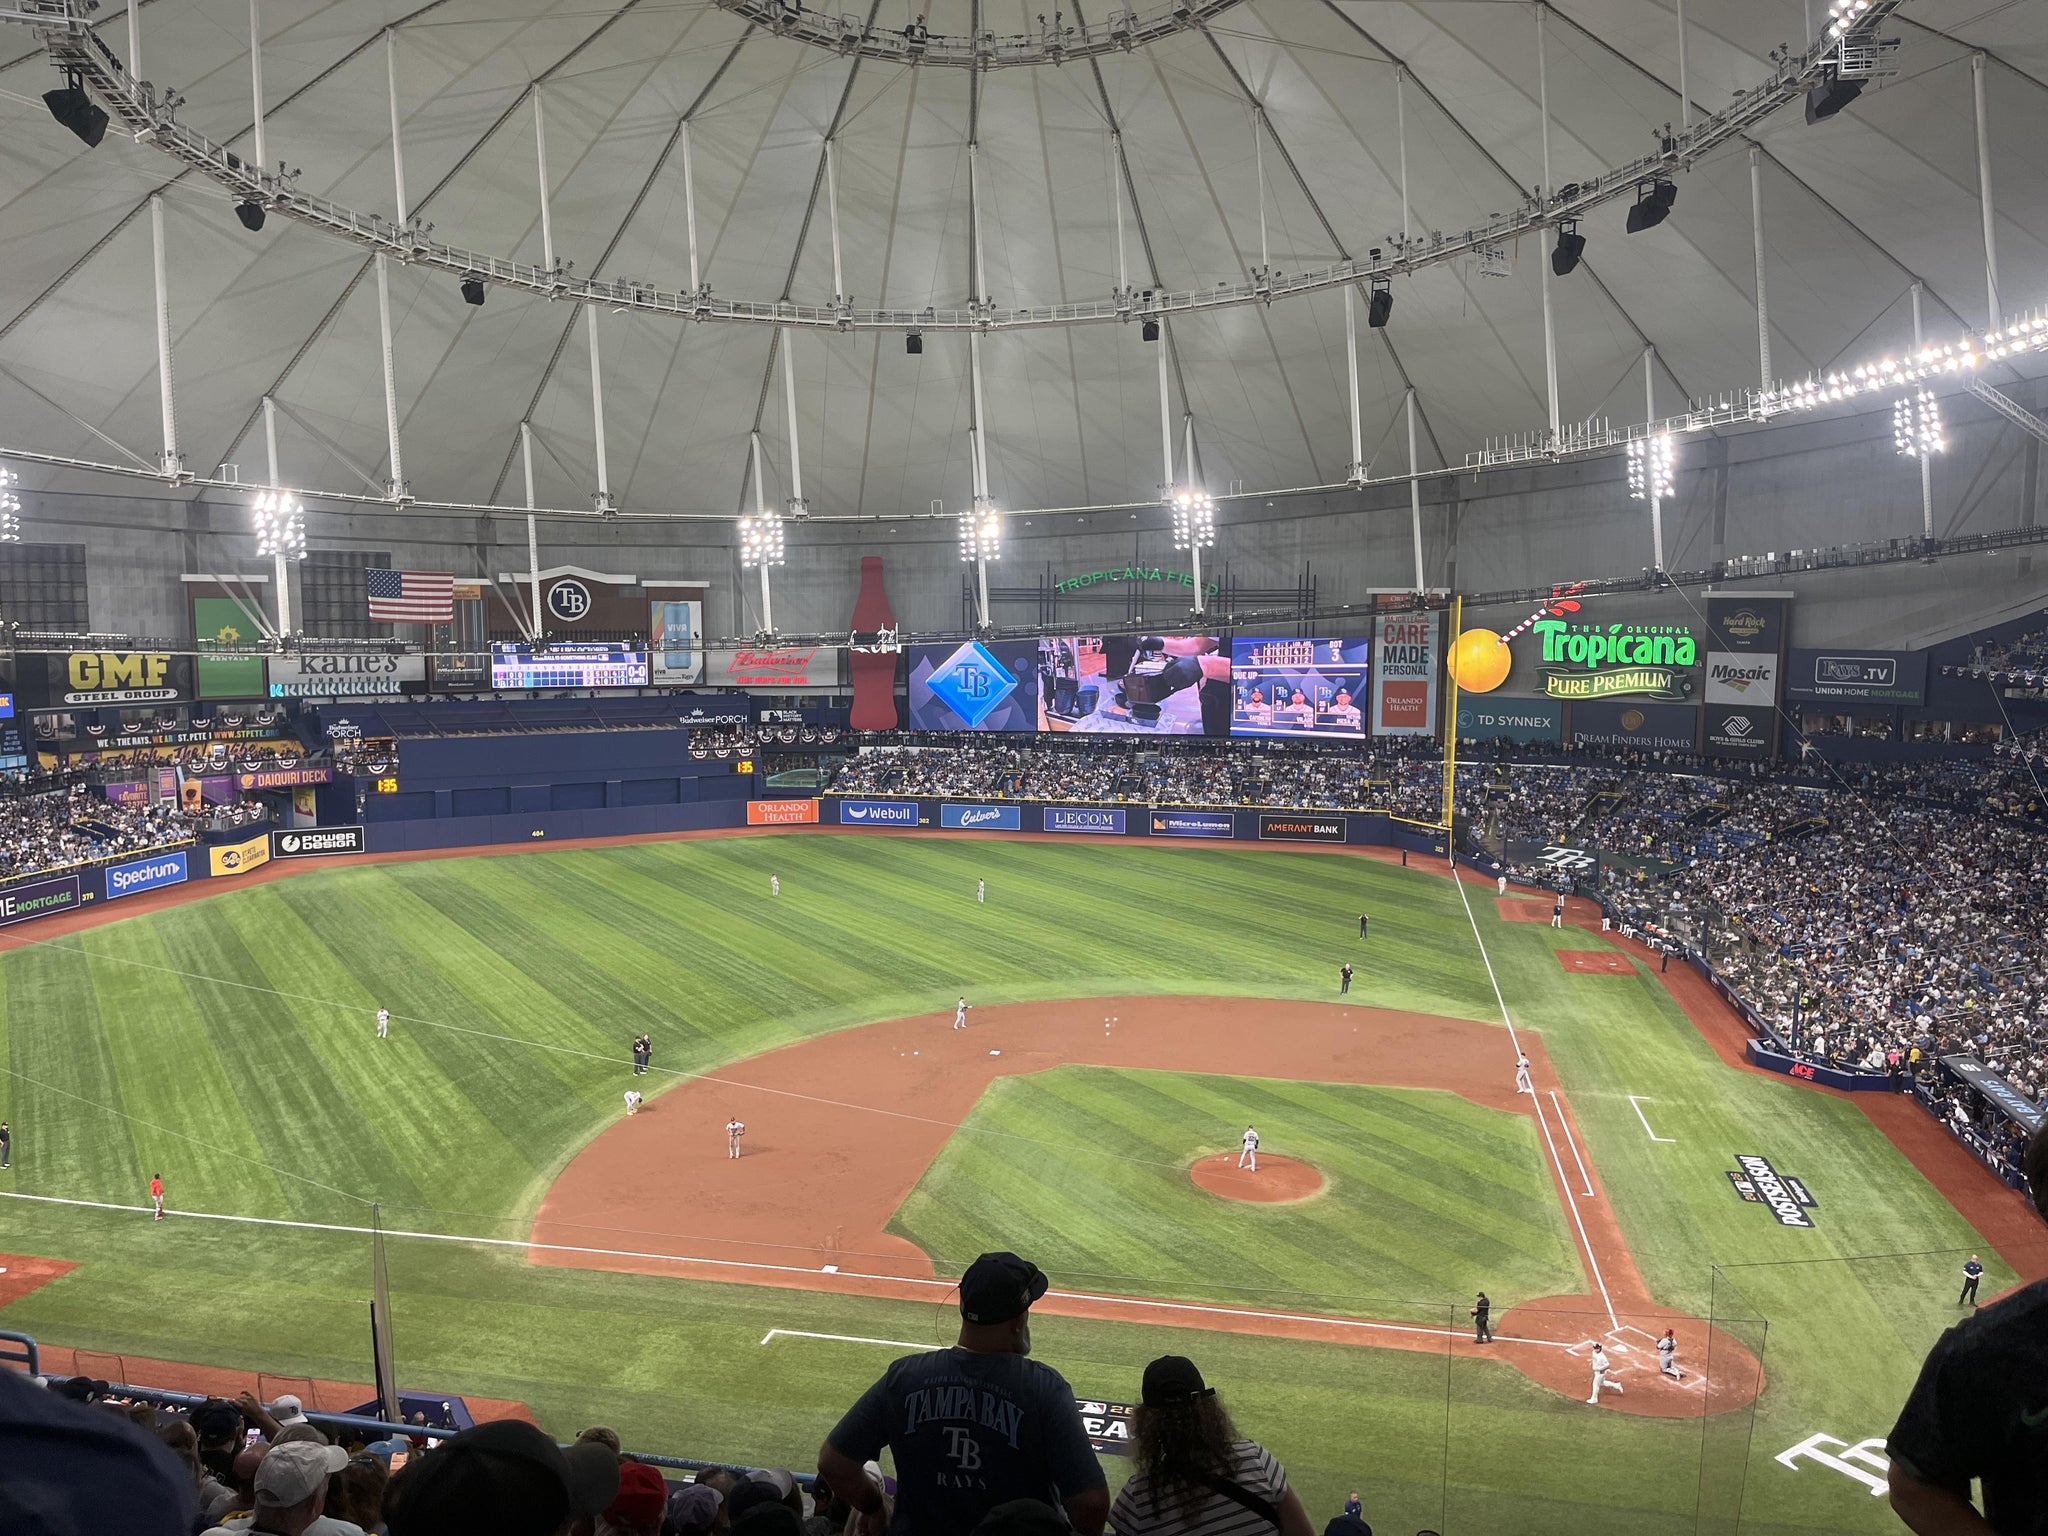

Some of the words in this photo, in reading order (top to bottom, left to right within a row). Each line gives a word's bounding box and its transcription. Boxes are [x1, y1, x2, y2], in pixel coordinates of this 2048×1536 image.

[1055, 568, 1161, 594] TROPICANA
[1167, 571, 1219, 596] FIED
[556, 588, 584, 614] TB
[1384, 625, 1430, 644] CARE
[1571, 625, 1600, 633] THE
[1627, 626, 1689, 634] ORIGINAL
[1329, 640, 1343, 649] BOT
[1533, 619, 1696, 668] Tropicana
[1331, 649, 1340, 662] 3
[1383, 646, 1429, 664] MADE
[68, 653, 171, 690] GMF
[1233, 672, 1247, 680] DUE
[1383, 665, 1428, 675] PERSONAL
[1711, 664, 1771, 681] Mosaic
[956, 664, 990, 700] TB
[1548, 675, 1590, 694] PURE
[1593, 672, 1672, 693] PREMIUM
[73, 691, 119, 702] STEEL
[124, 690, 170, 700] GROUP
[1815, 686, 1842, 695] UNION
[1844, 688, 1869, 696] HOME
[1871, 689, 1920, 698] MORTGAGE
[1386, 697, 1422, 705] ORLANDO
[715, 715, 747, 723] PORCH
[1478, 714, 1494, 725] TD
[1497, 715, 1551, 728] SYNNEX
[97, 739, 109, 748] WE
[117, 738, 132, 747] THE
[1574, 732, 1609, 744] DREAM
[1612, 733, 1650, 746] FINDERS
[1653, 735, 1690, 747] HOMES
[738, 761, 754, 773] 1:35
[258, 771, 300, 786] DAIQUIRI
[302, 770, 327, 783] DECK
[378, 778, 398, 793] 1:35
[135, 783, 148, 791] FAN
[758, 803, 809, 813] ORLANDO
[869, 807, 910, 820] Webull
[764, 812, 802, 822] HEALTH
[961, 808, 1001, 827] Culver's
[1055, 812, 1113, 825] LECOM
[1267, 823, 1313, 833] AMERANT
[1314, 825, 1339, 834] BANK
[113, 862, 173, 889] Spectrum
[16, 891, 72, 913] MORTGAGE
[1790, 1063, 1815, 1078] ACE
[1739, 1155, 1809, 1227] POSTSEASON
[904, 1386, 977, 1435] TAMPA
[979, 1390, 1025, 1450] BAY
[943, 1426, 982, 1470] TB
[936, 1471, 987, 1490] RAYS
